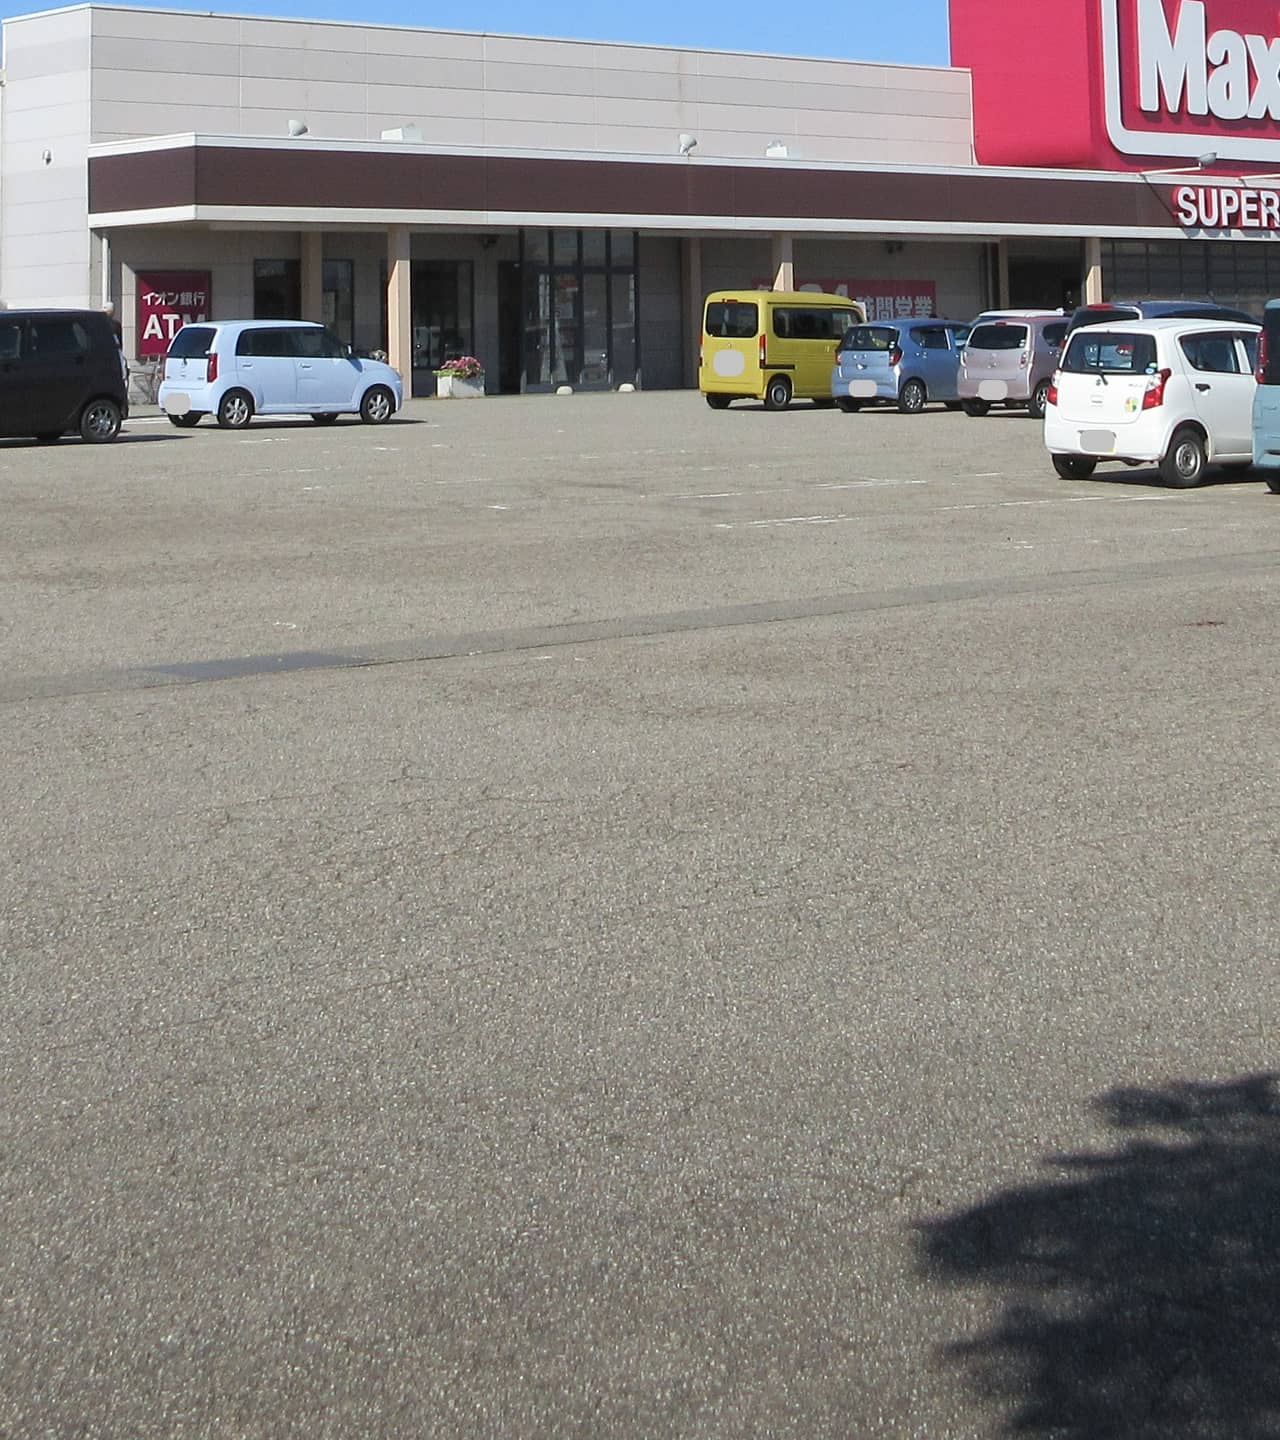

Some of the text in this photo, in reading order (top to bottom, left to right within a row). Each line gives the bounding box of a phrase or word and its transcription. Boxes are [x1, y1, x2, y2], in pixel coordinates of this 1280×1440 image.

[142, 292, 205, 306] イオン銀行
